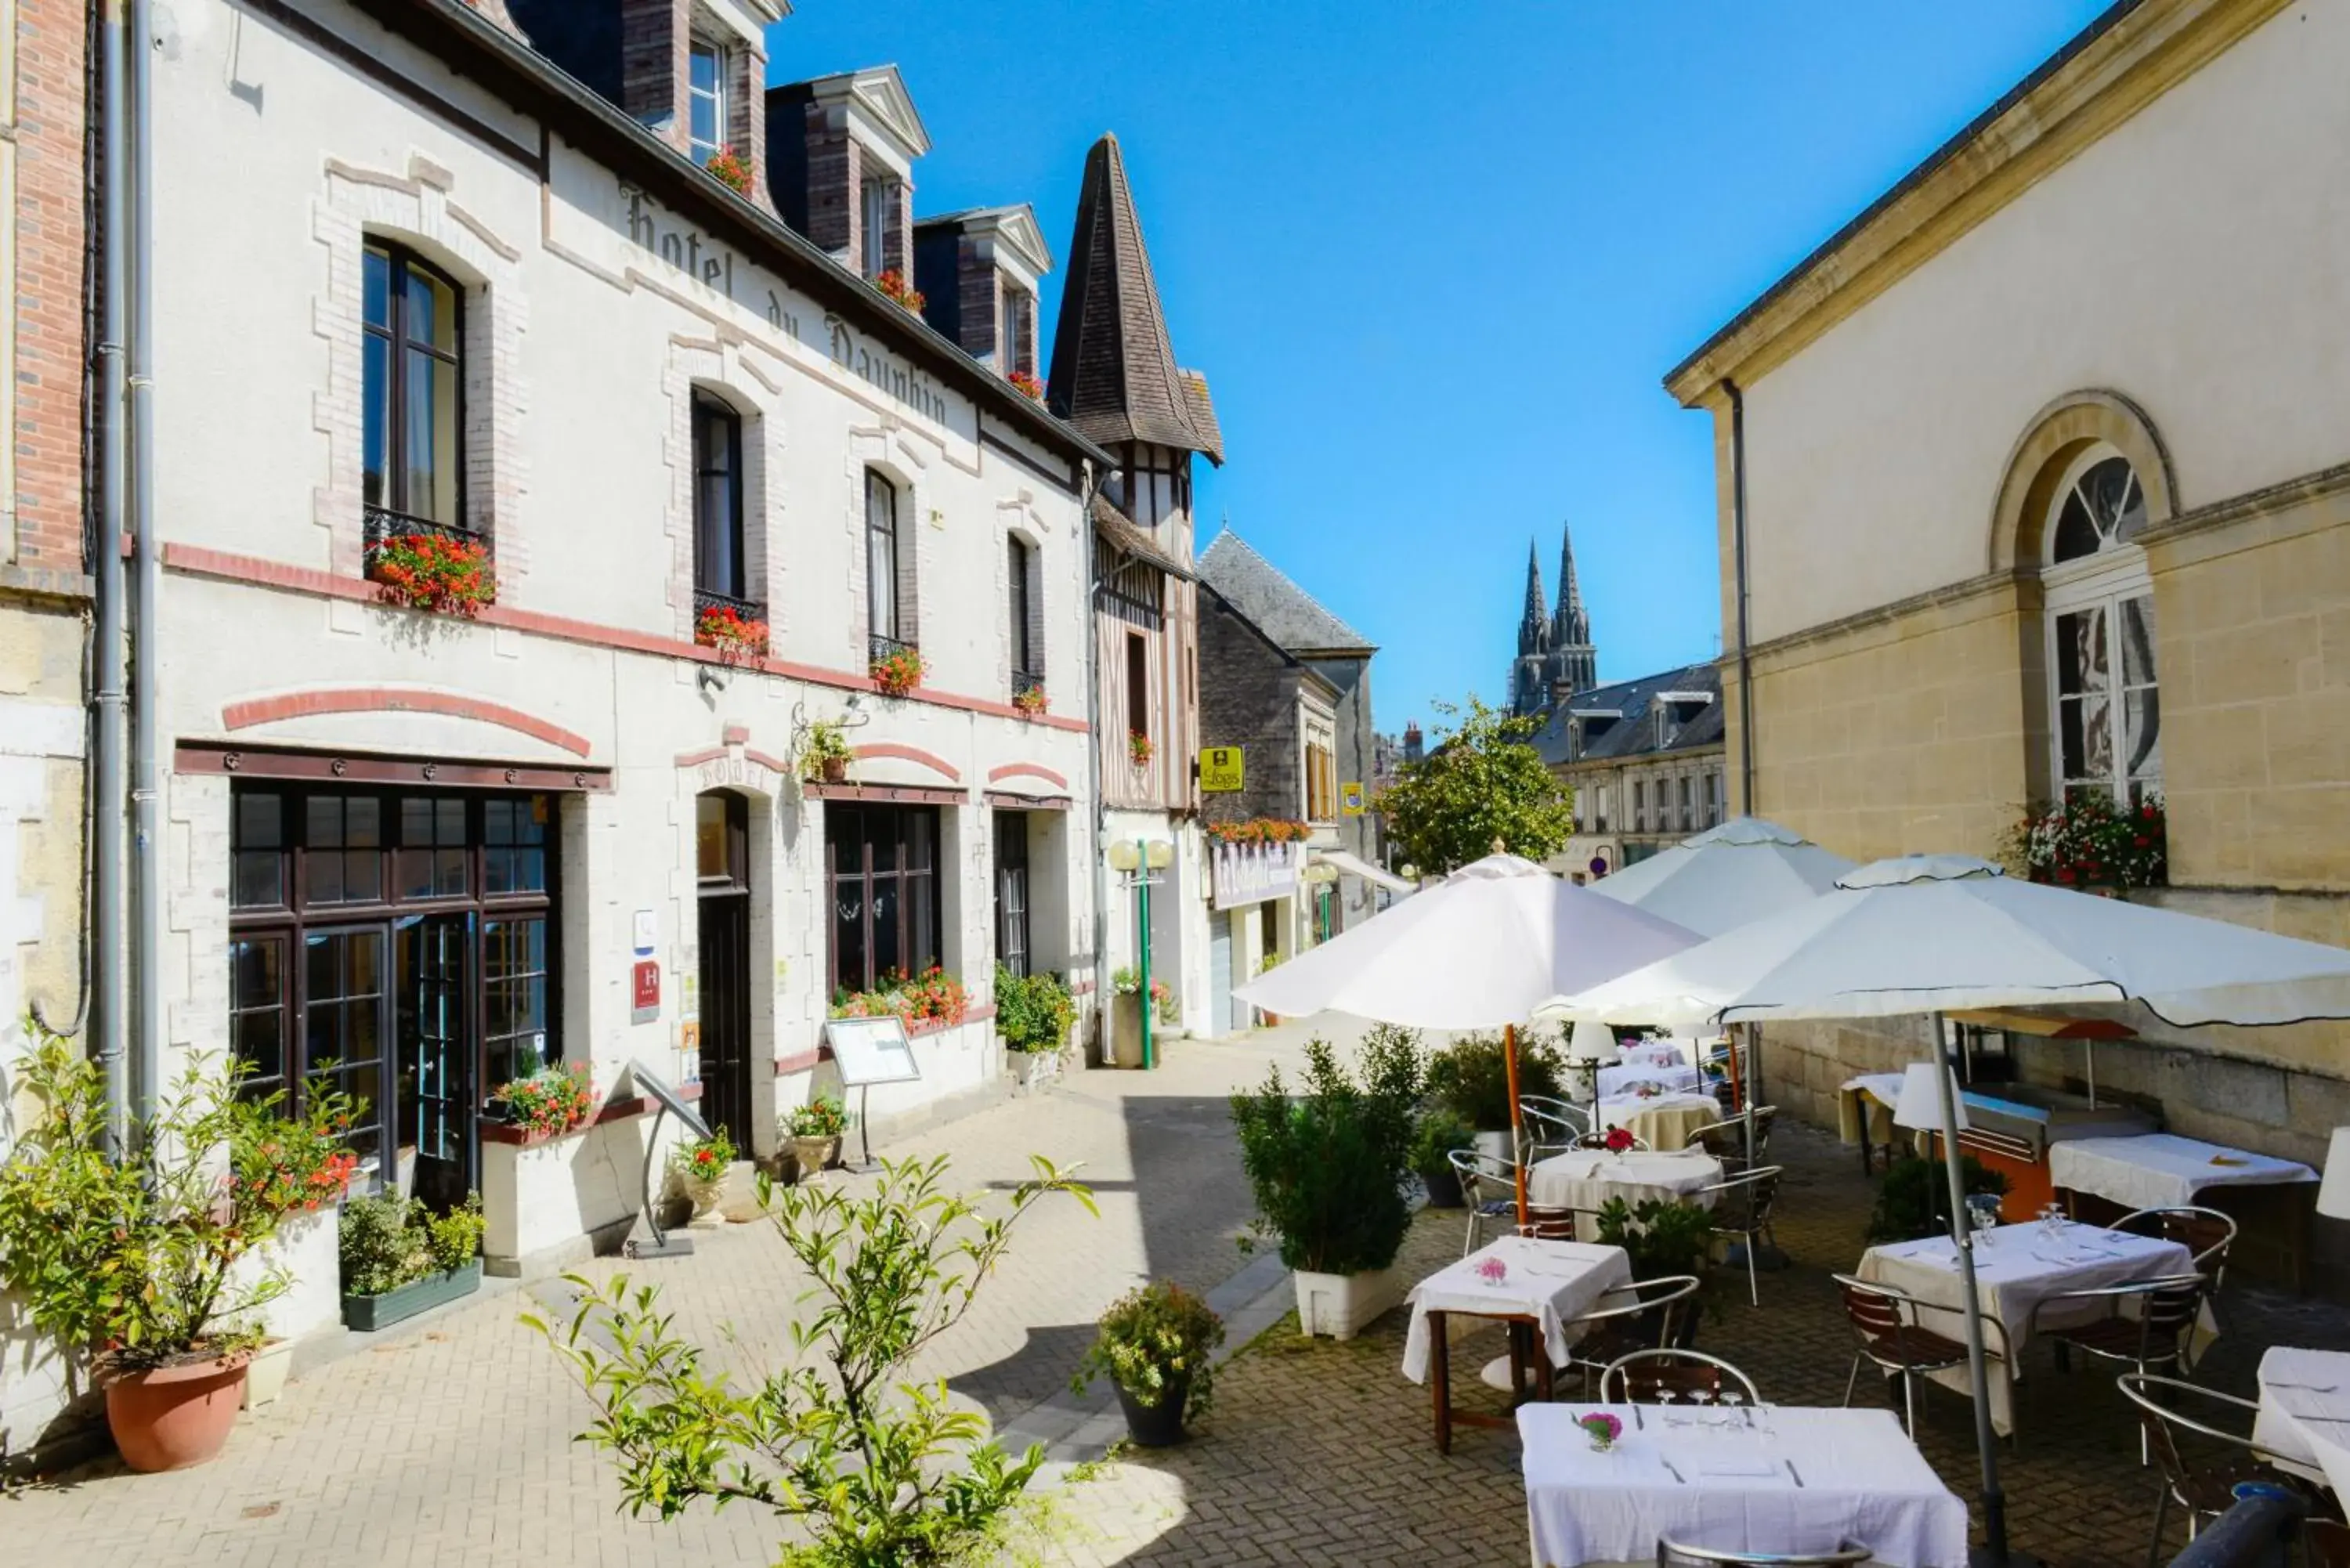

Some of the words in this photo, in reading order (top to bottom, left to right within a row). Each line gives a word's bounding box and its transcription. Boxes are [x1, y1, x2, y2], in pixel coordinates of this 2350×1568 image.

[768, 289, 800, 349] du
[823, 312, 946, 428] Dauphin
[645, 968, 657, 986] H
